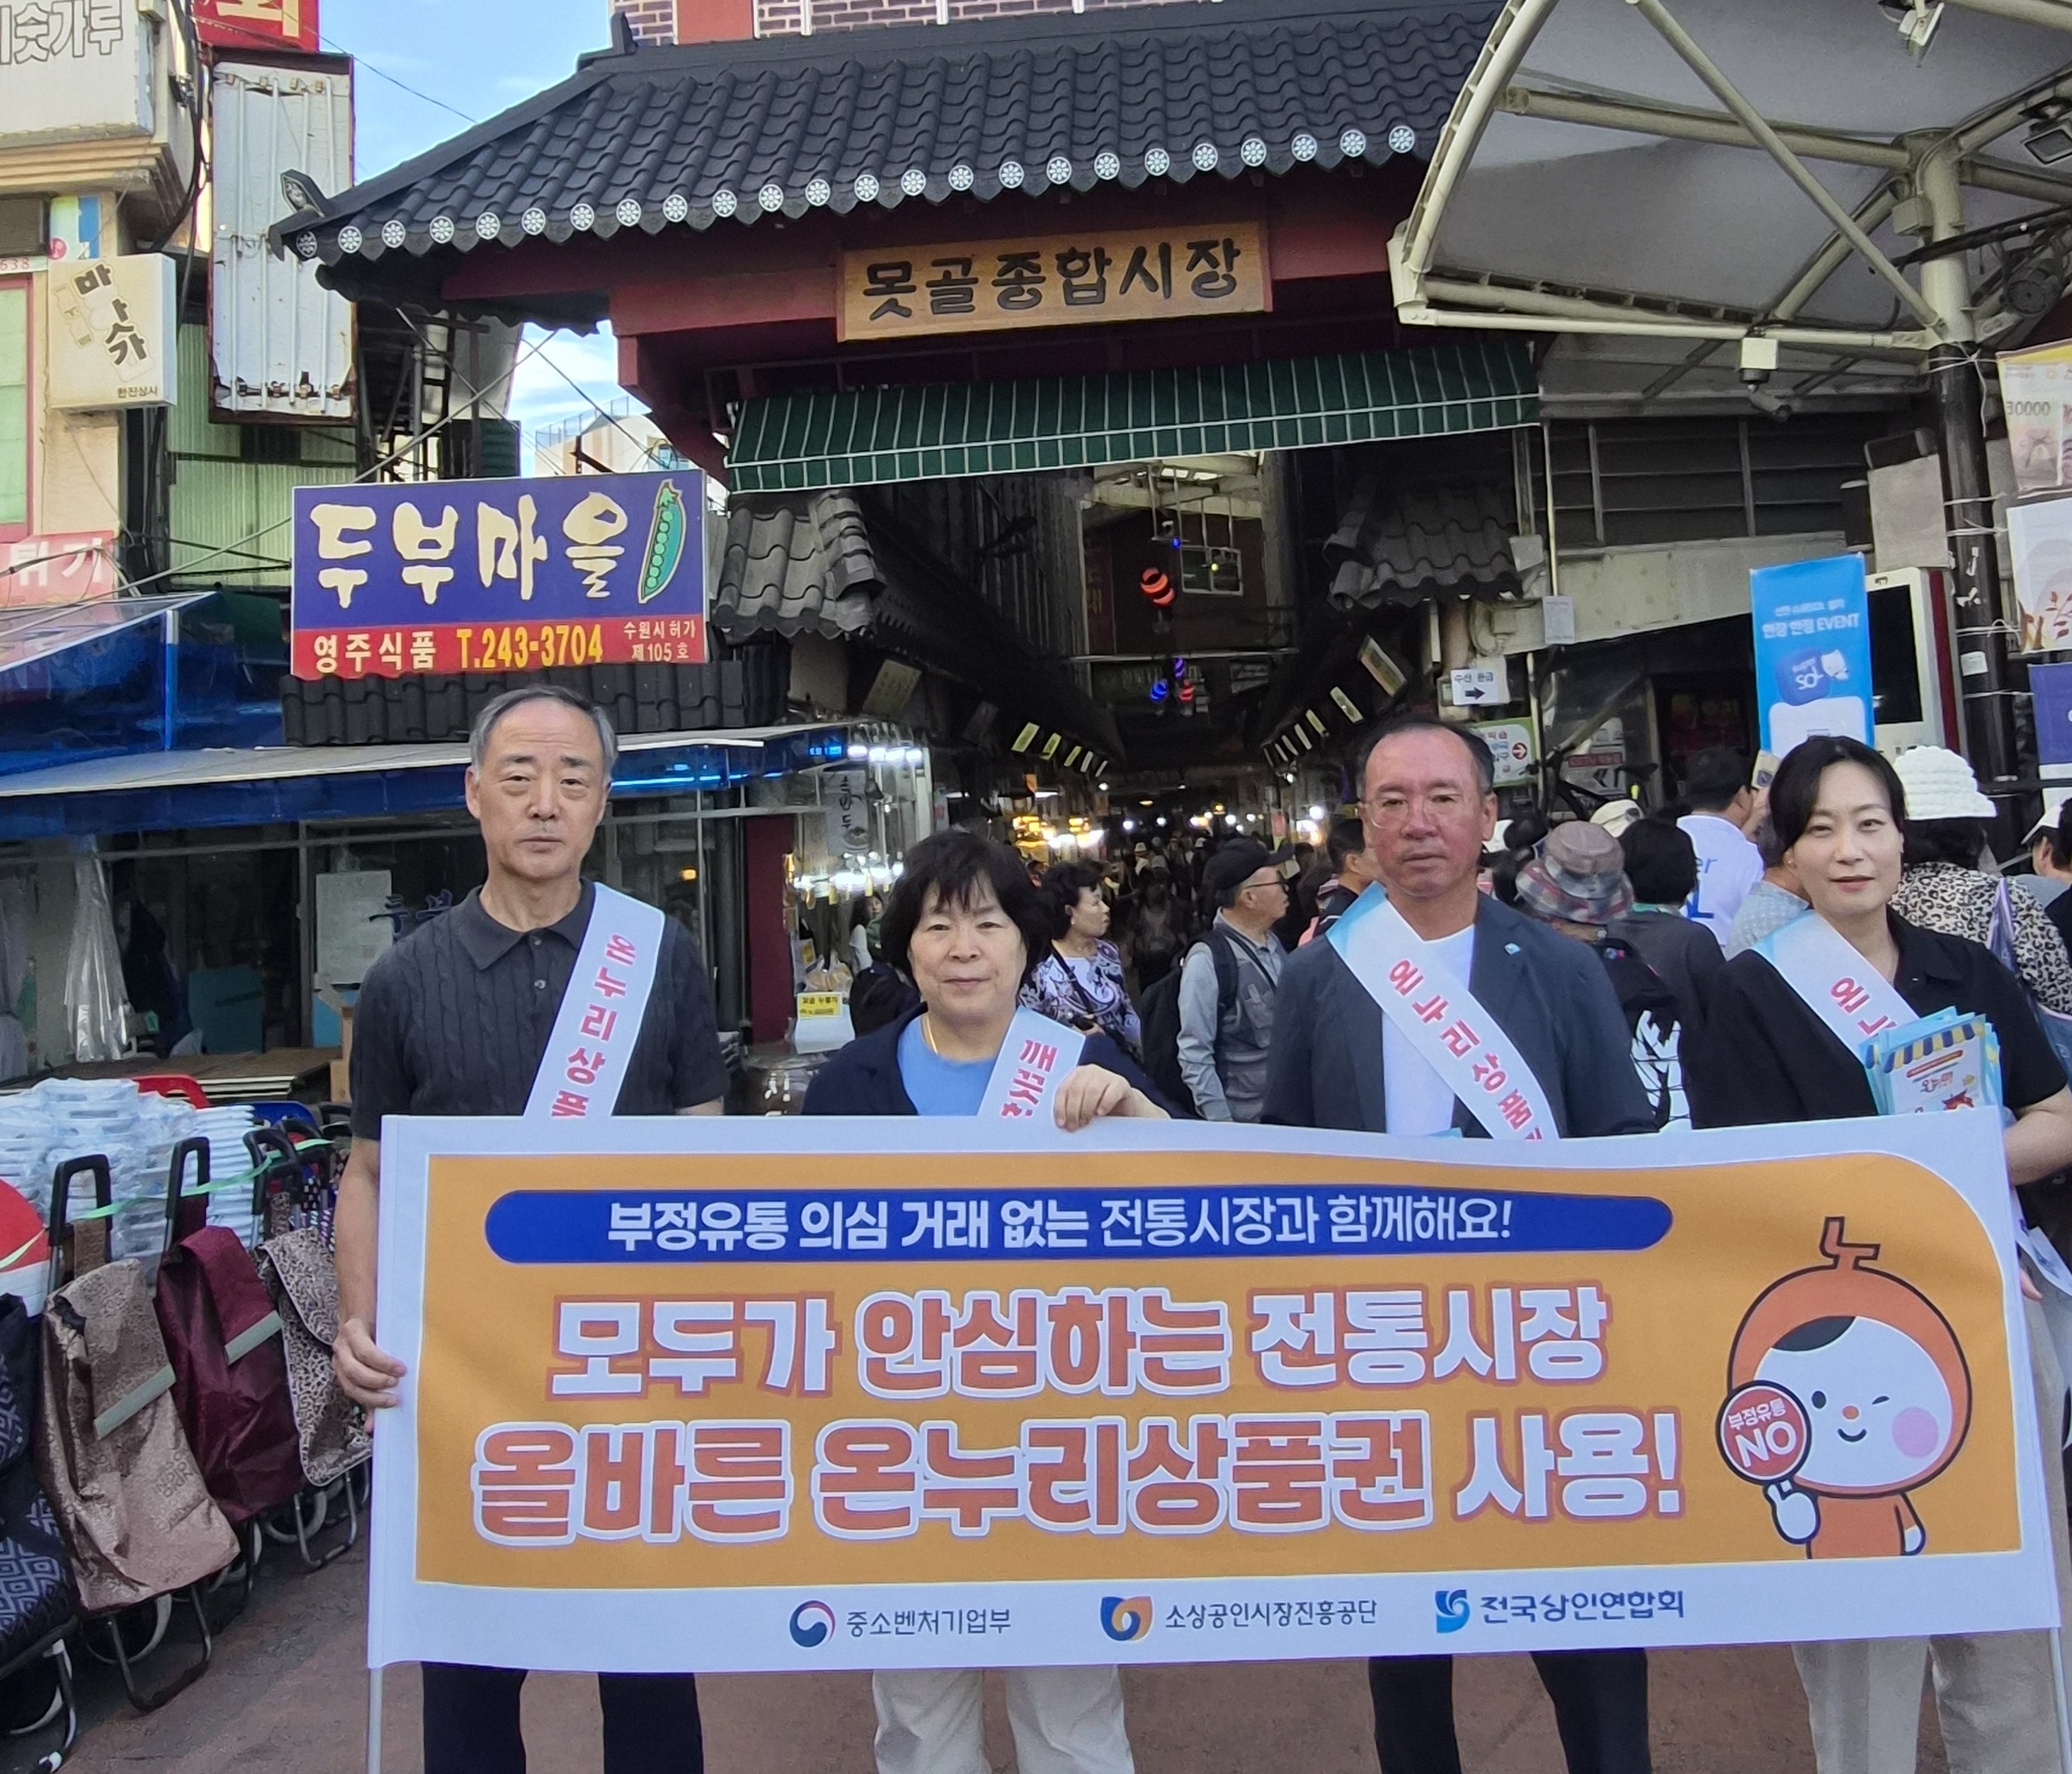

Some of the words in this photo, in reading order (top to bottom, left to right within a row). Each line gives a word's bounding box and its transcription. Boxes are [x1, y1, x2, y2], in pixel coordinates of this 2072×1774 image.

[863, 237, 1241, 320] 못골종합시장
[310, 491, 628, 608] 두부마을
[313, 630, 437, 674] 영주식품
[456, 623, 602, 669] T.243-3704
[1816, 613, 1860, 632] EVENT
[1389, 959, 1542, 1140] 온누리상품
[608, 1199, 789, 1251] 부정유통
[798, 1200, 887, 1250] 의심
[901, 1199, 989, 1248] 거래
[1000, 1199, 1089, 1248] 없는
[1101, 1196, 1319, 1247] 전통시장과
[1328, 1194, 1512, 1244] 함께해요!
[550, 1293, 838, 1397] 모두가
[856, 1286, 1232, 1400] 안심하는
[1249, 1285, 1609, 1386] 전통시장
[1735, 1420, 1796, 1468] NO
[471, 1420, 794, 1544] 올바른
[810, 1410, 1432, 1539] 온누리상품권
[1453, 1410, 1682, 1521] 사용!
[847, 1608, 1011, 1638] 중소벤처기업부
[1164, 1598, 1378, 1631] 소상공인시장진흥공단
[1480, 1590, 1685, 1625] 전국상인연합회
